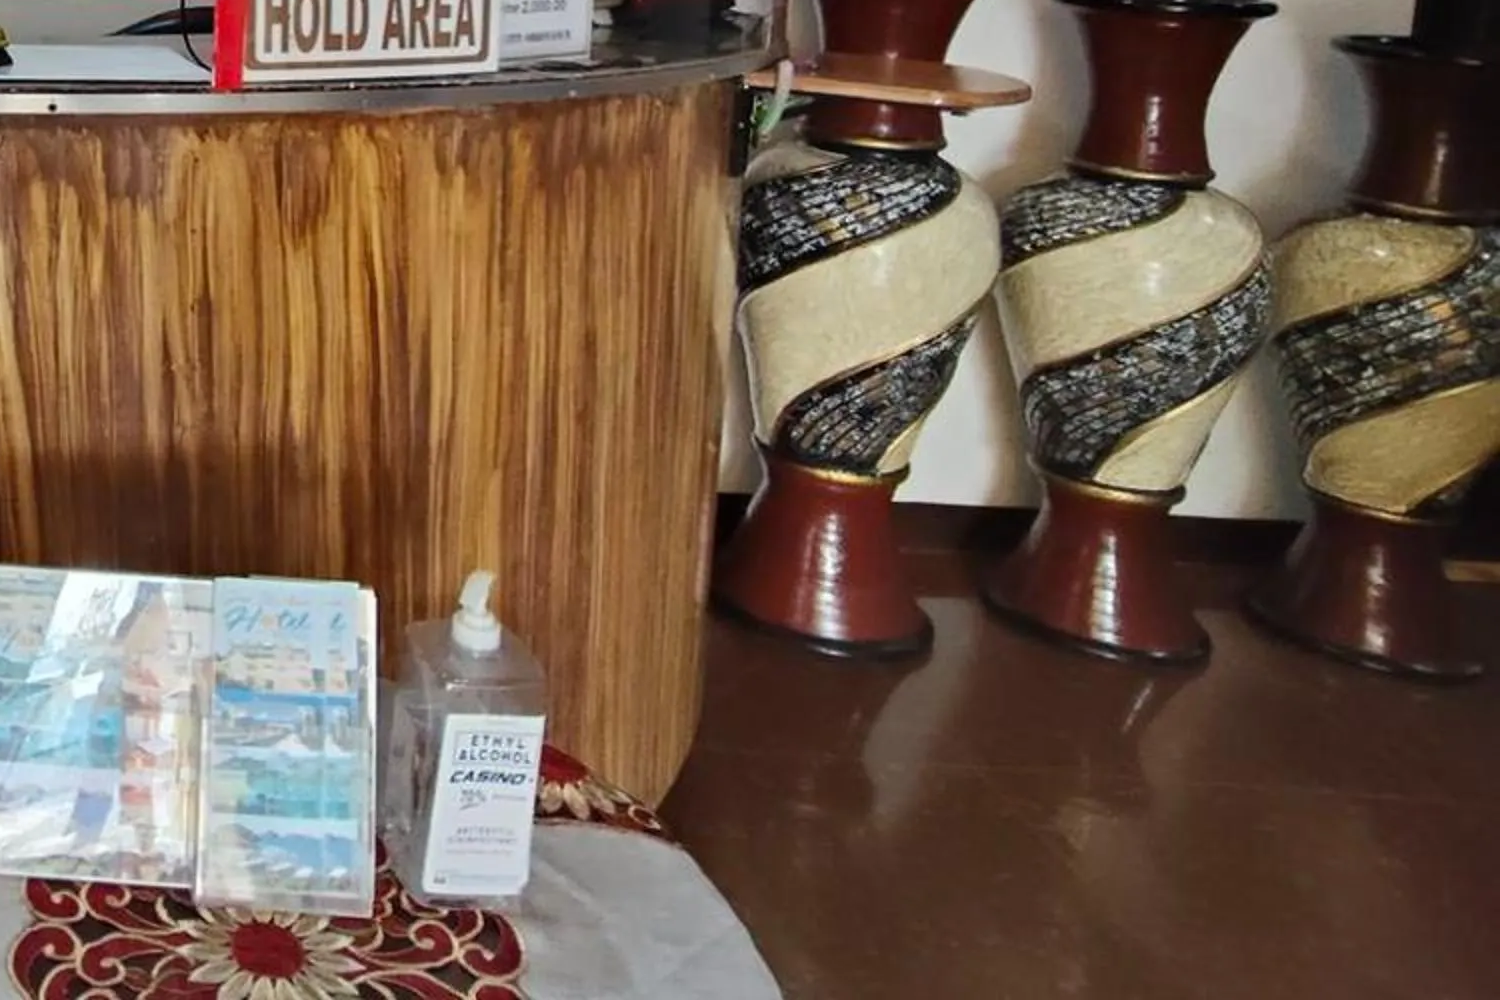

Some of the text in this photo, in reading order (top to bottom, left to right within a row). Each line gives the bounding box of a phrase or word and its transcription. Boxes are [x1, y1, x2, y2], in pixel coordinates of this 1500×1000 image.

[471, 734, 526, 749] ETHYL
[458, 749, 532, 765] ALCOHOL
[450, 770, 527, 785] CASINO
